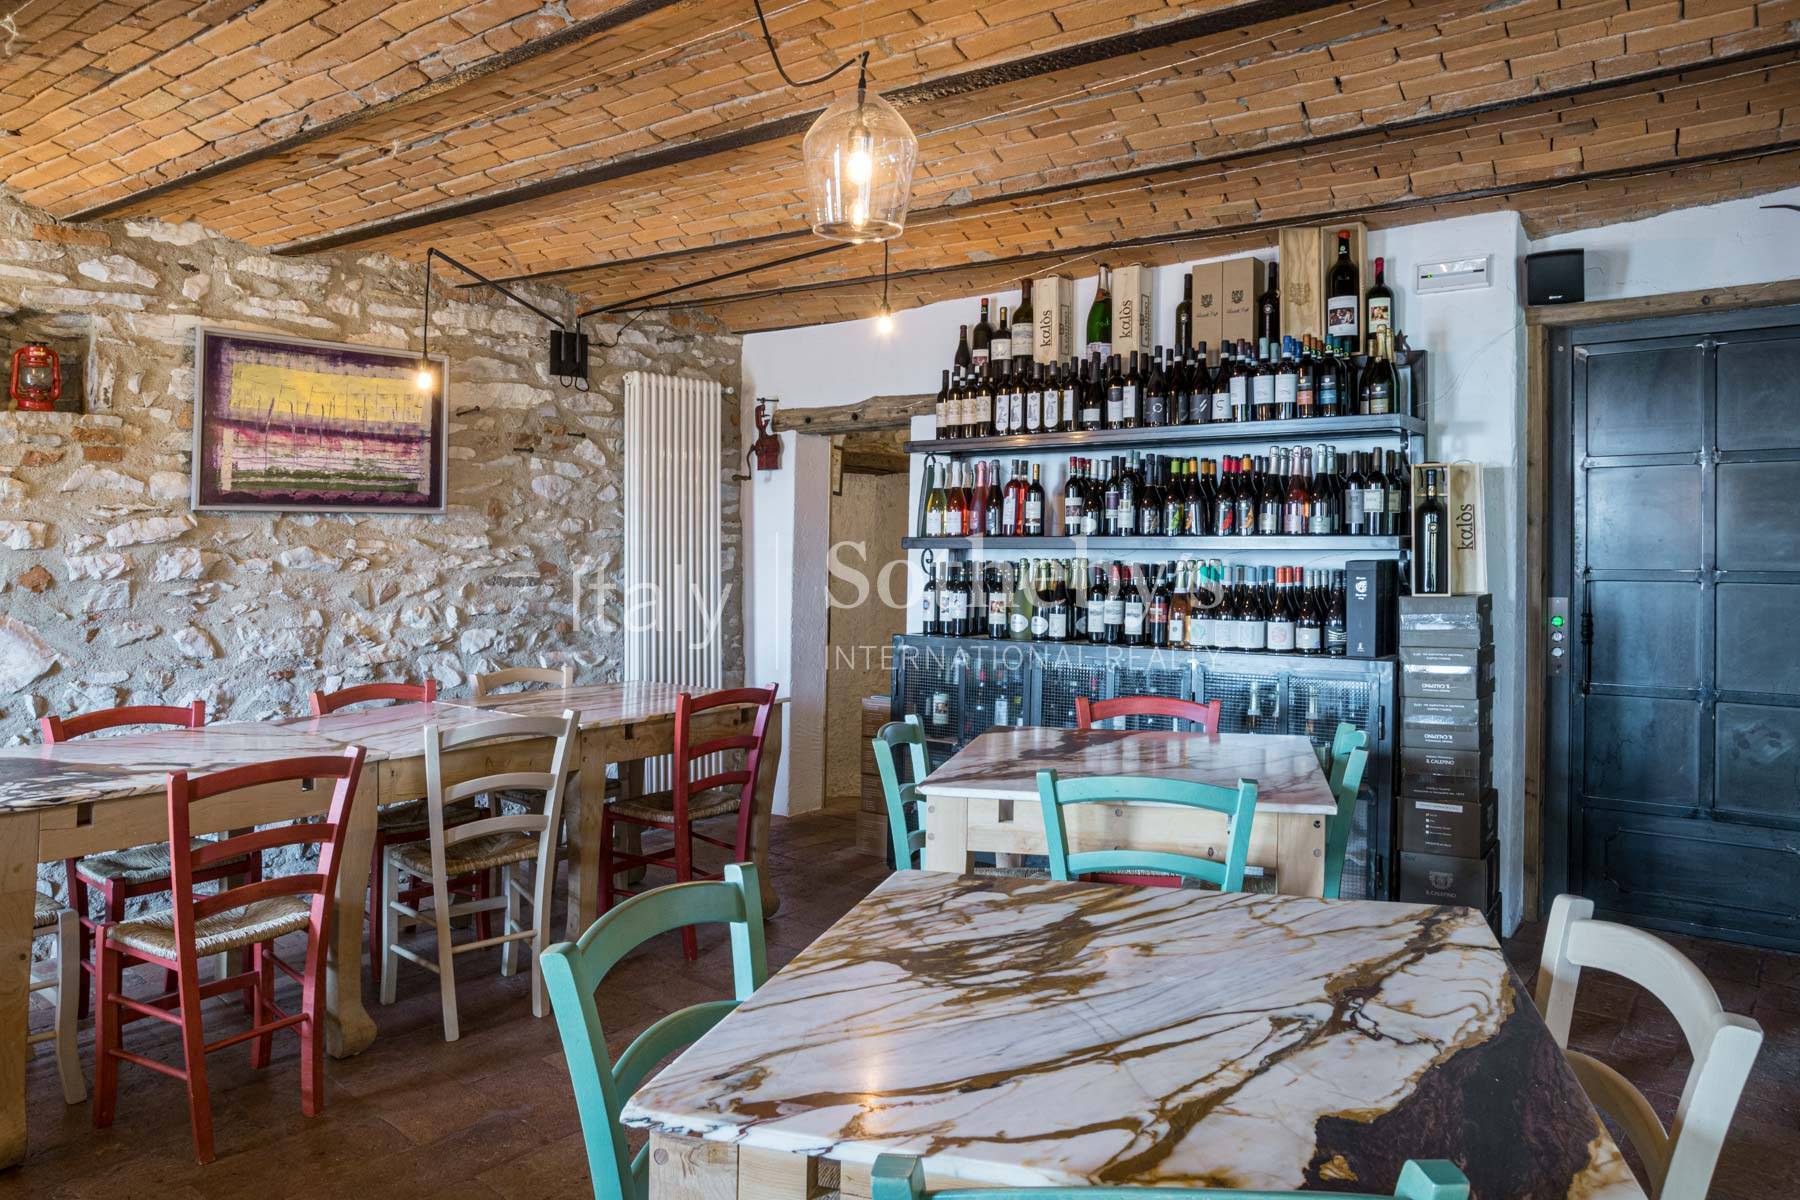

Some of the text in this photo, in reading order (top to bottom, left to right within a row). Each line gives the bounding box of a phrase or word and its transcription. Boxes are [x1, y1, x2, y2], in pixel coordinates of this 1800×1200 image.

[1040, 310, 1051, 347] kalòs
[1119, 300, 1132, 338] kalòs
[1456, 504, 1474, 550] kalòs
